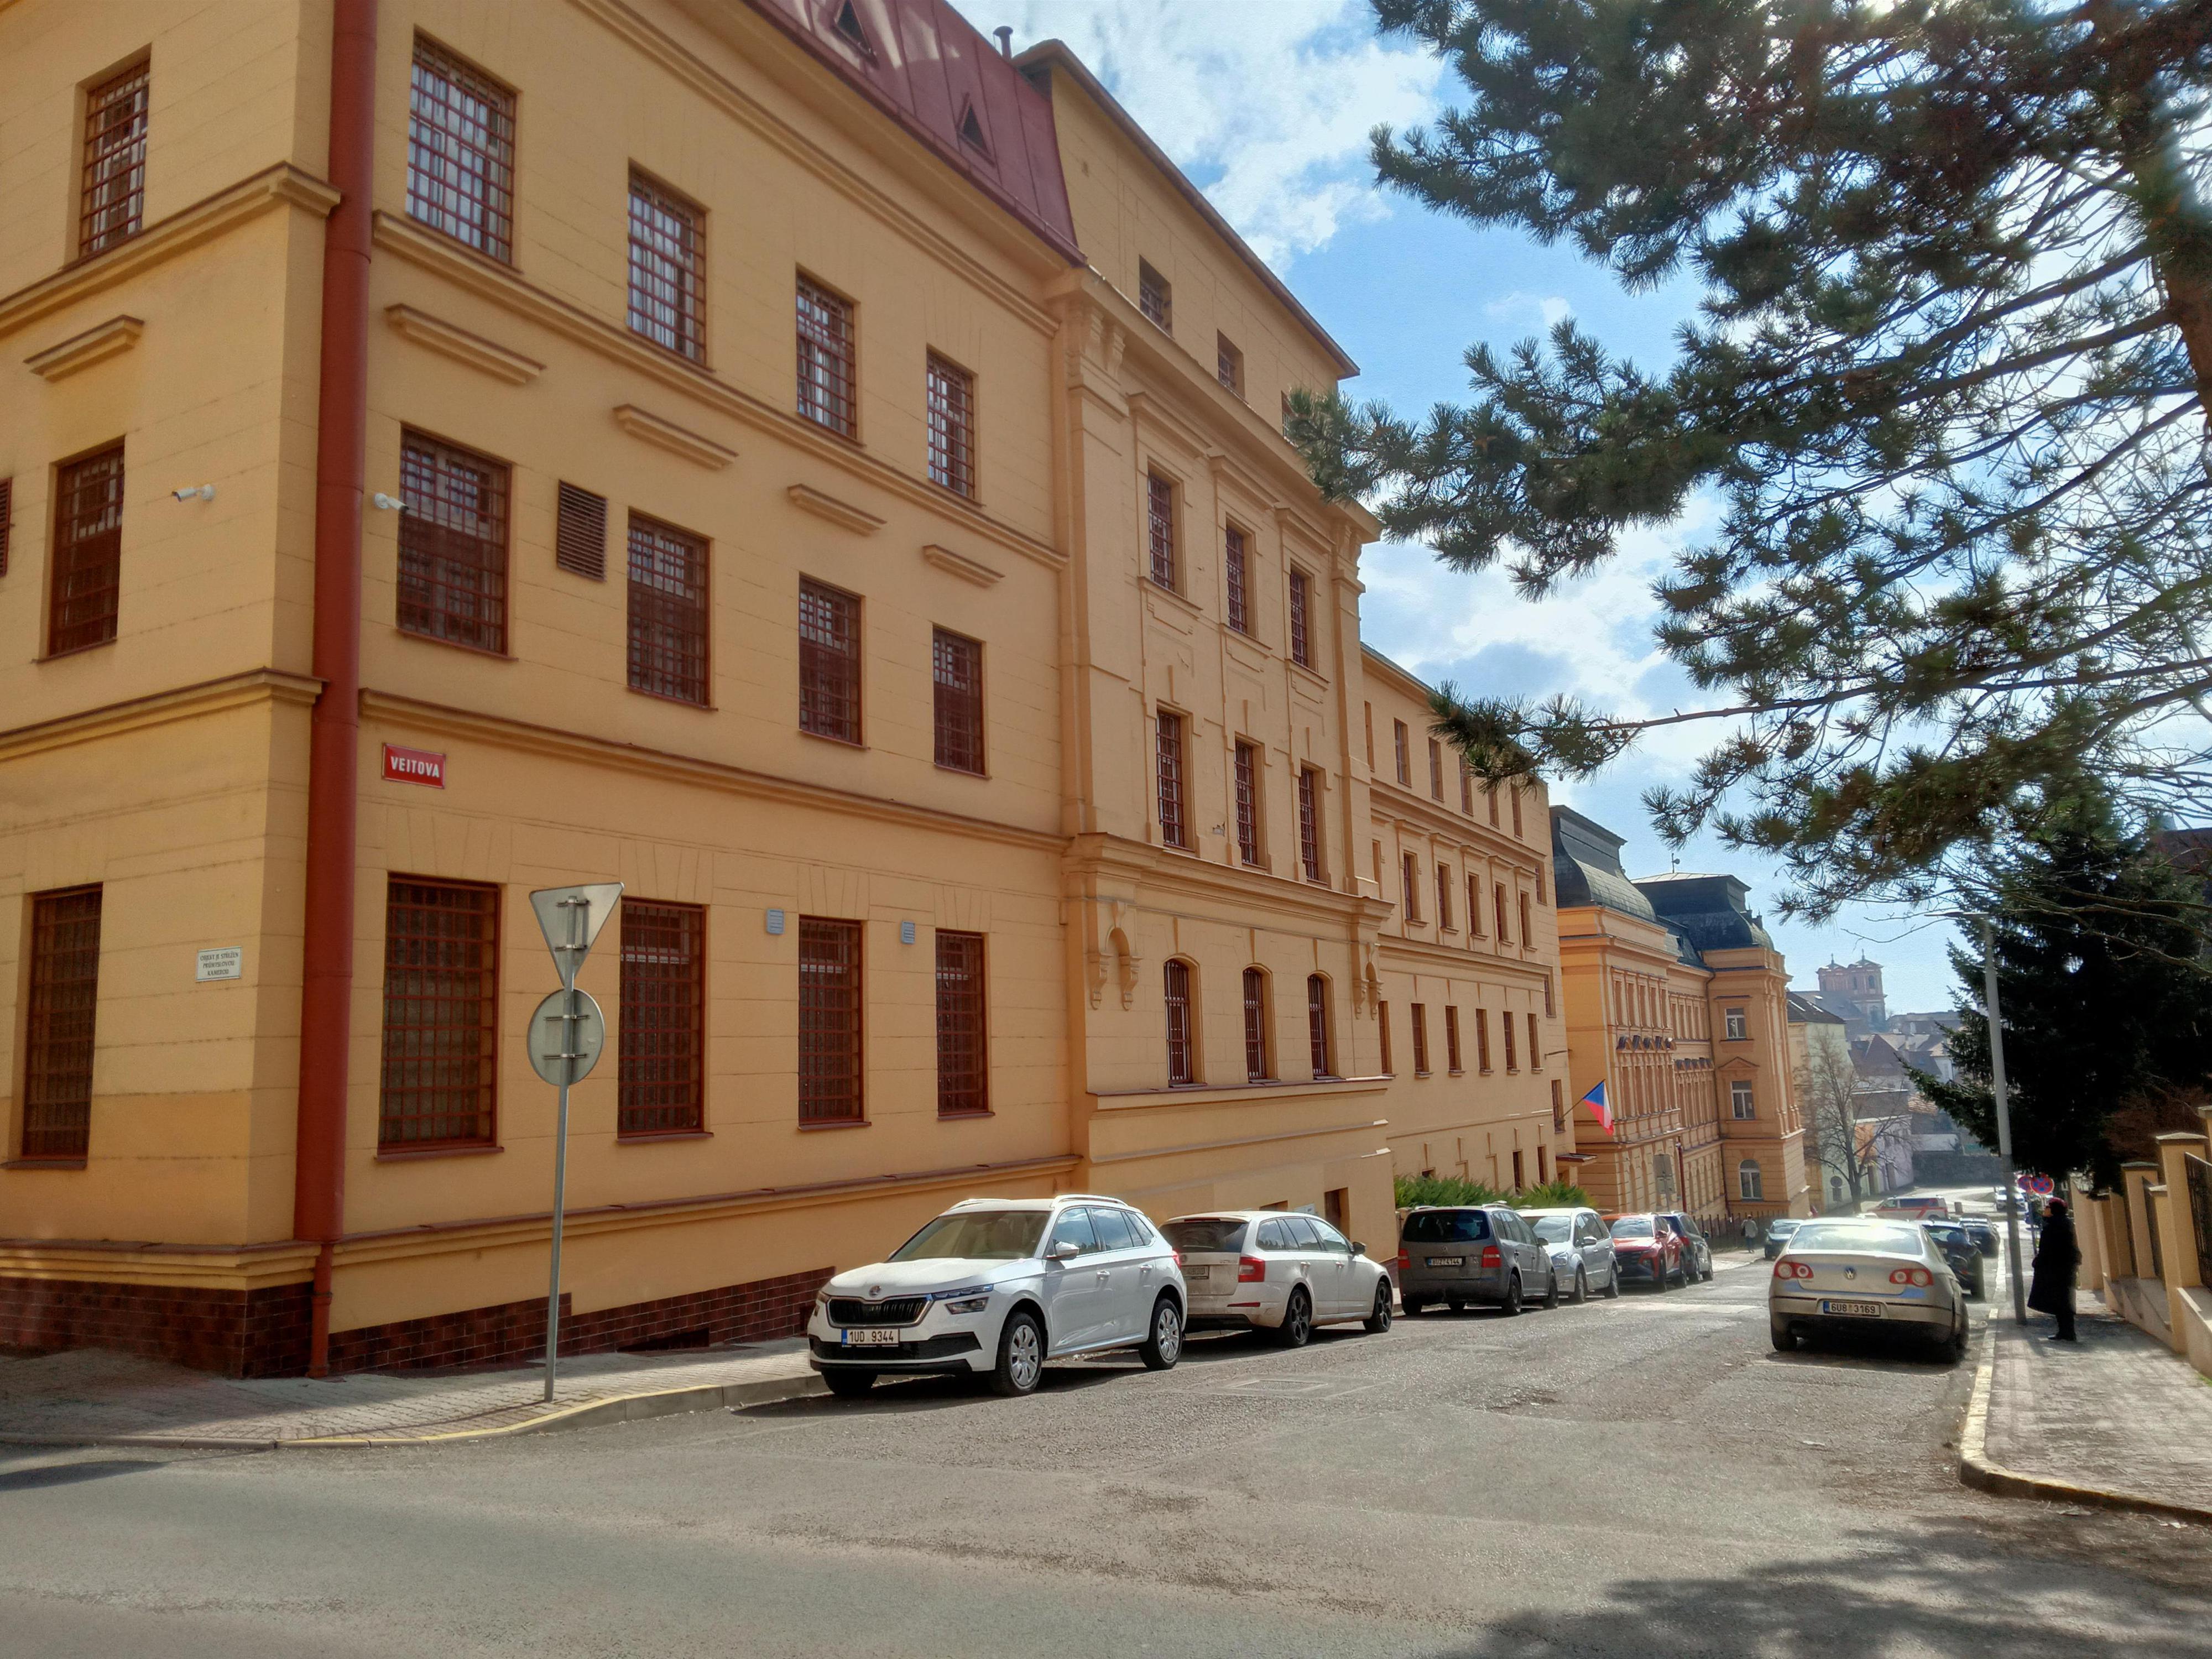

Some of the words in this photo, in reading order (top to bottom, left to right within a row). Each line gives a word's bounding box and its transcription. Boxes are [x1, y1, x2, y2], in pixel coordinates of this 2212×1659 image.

[390, 756, 440, 778] VEITOVA
[1831, 1303, 1848, 1312] 6U8
[1854, 1305, 1876, 1314] 3169
[849, 1331, 865, 1342] 1UD
[872, 1331, 894, 1342] 9344
